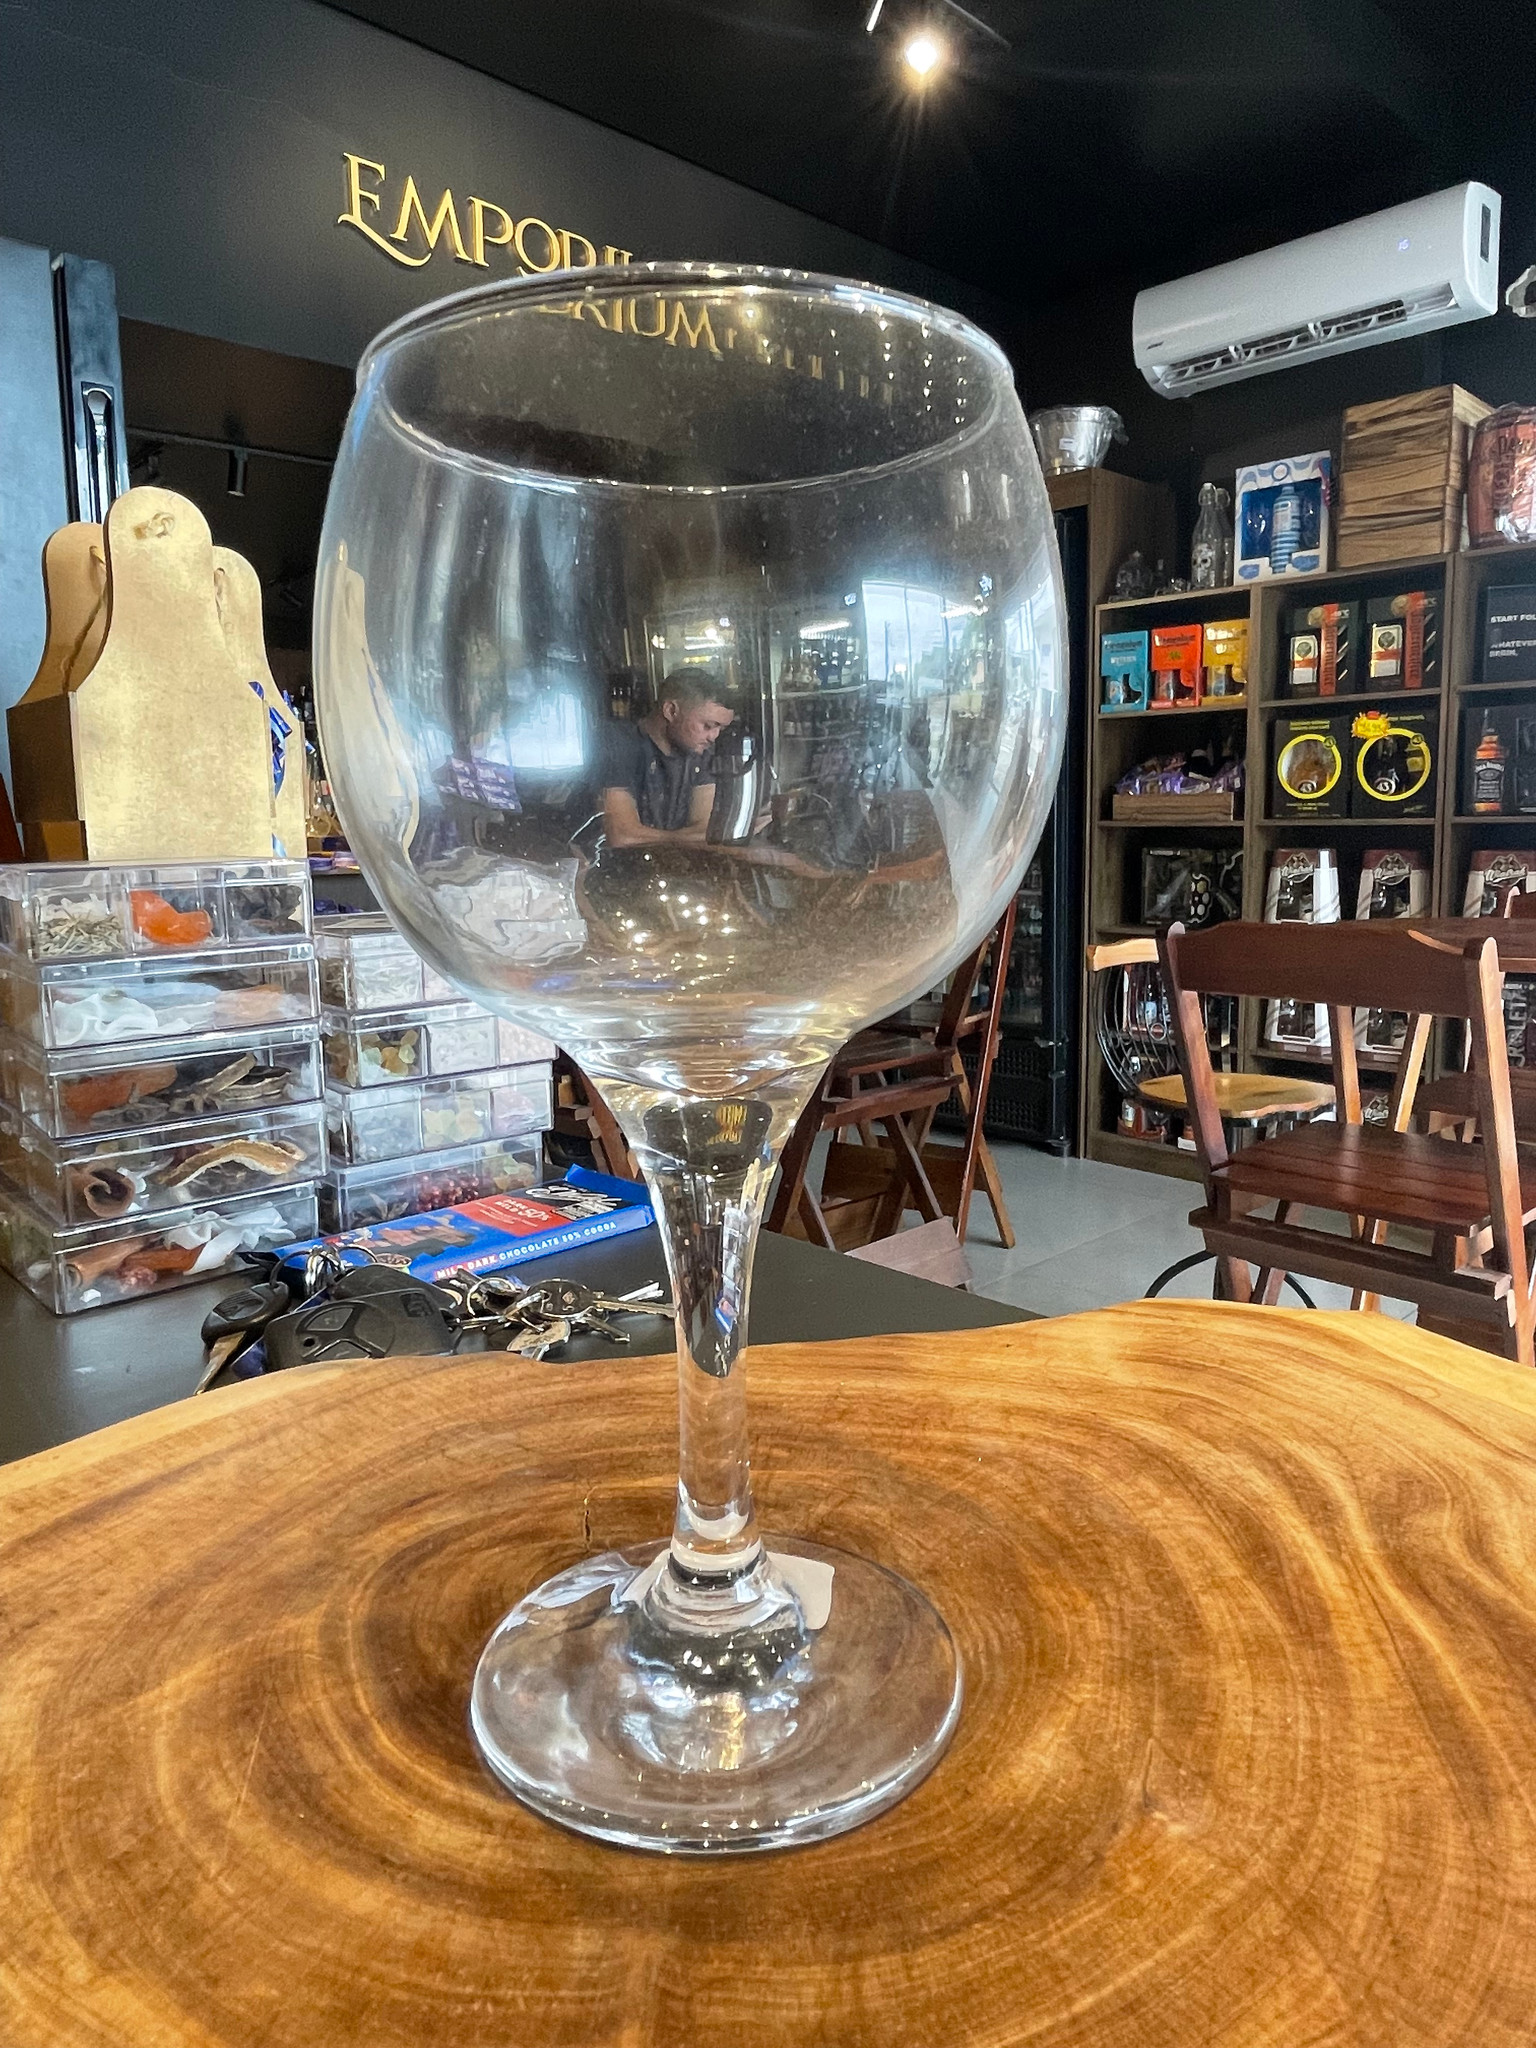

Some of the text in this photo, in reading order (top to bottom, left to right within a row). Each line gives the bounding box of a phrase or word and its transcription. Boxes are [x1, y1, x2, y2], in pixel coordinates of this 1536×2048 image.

[1490, 615, 1518, 623] START
[467, 1255, 497, 1270] DARK
[498, 1236, 559, 1261] CHOCOLATE
[584, 1221, 617, 1237] COCOA
